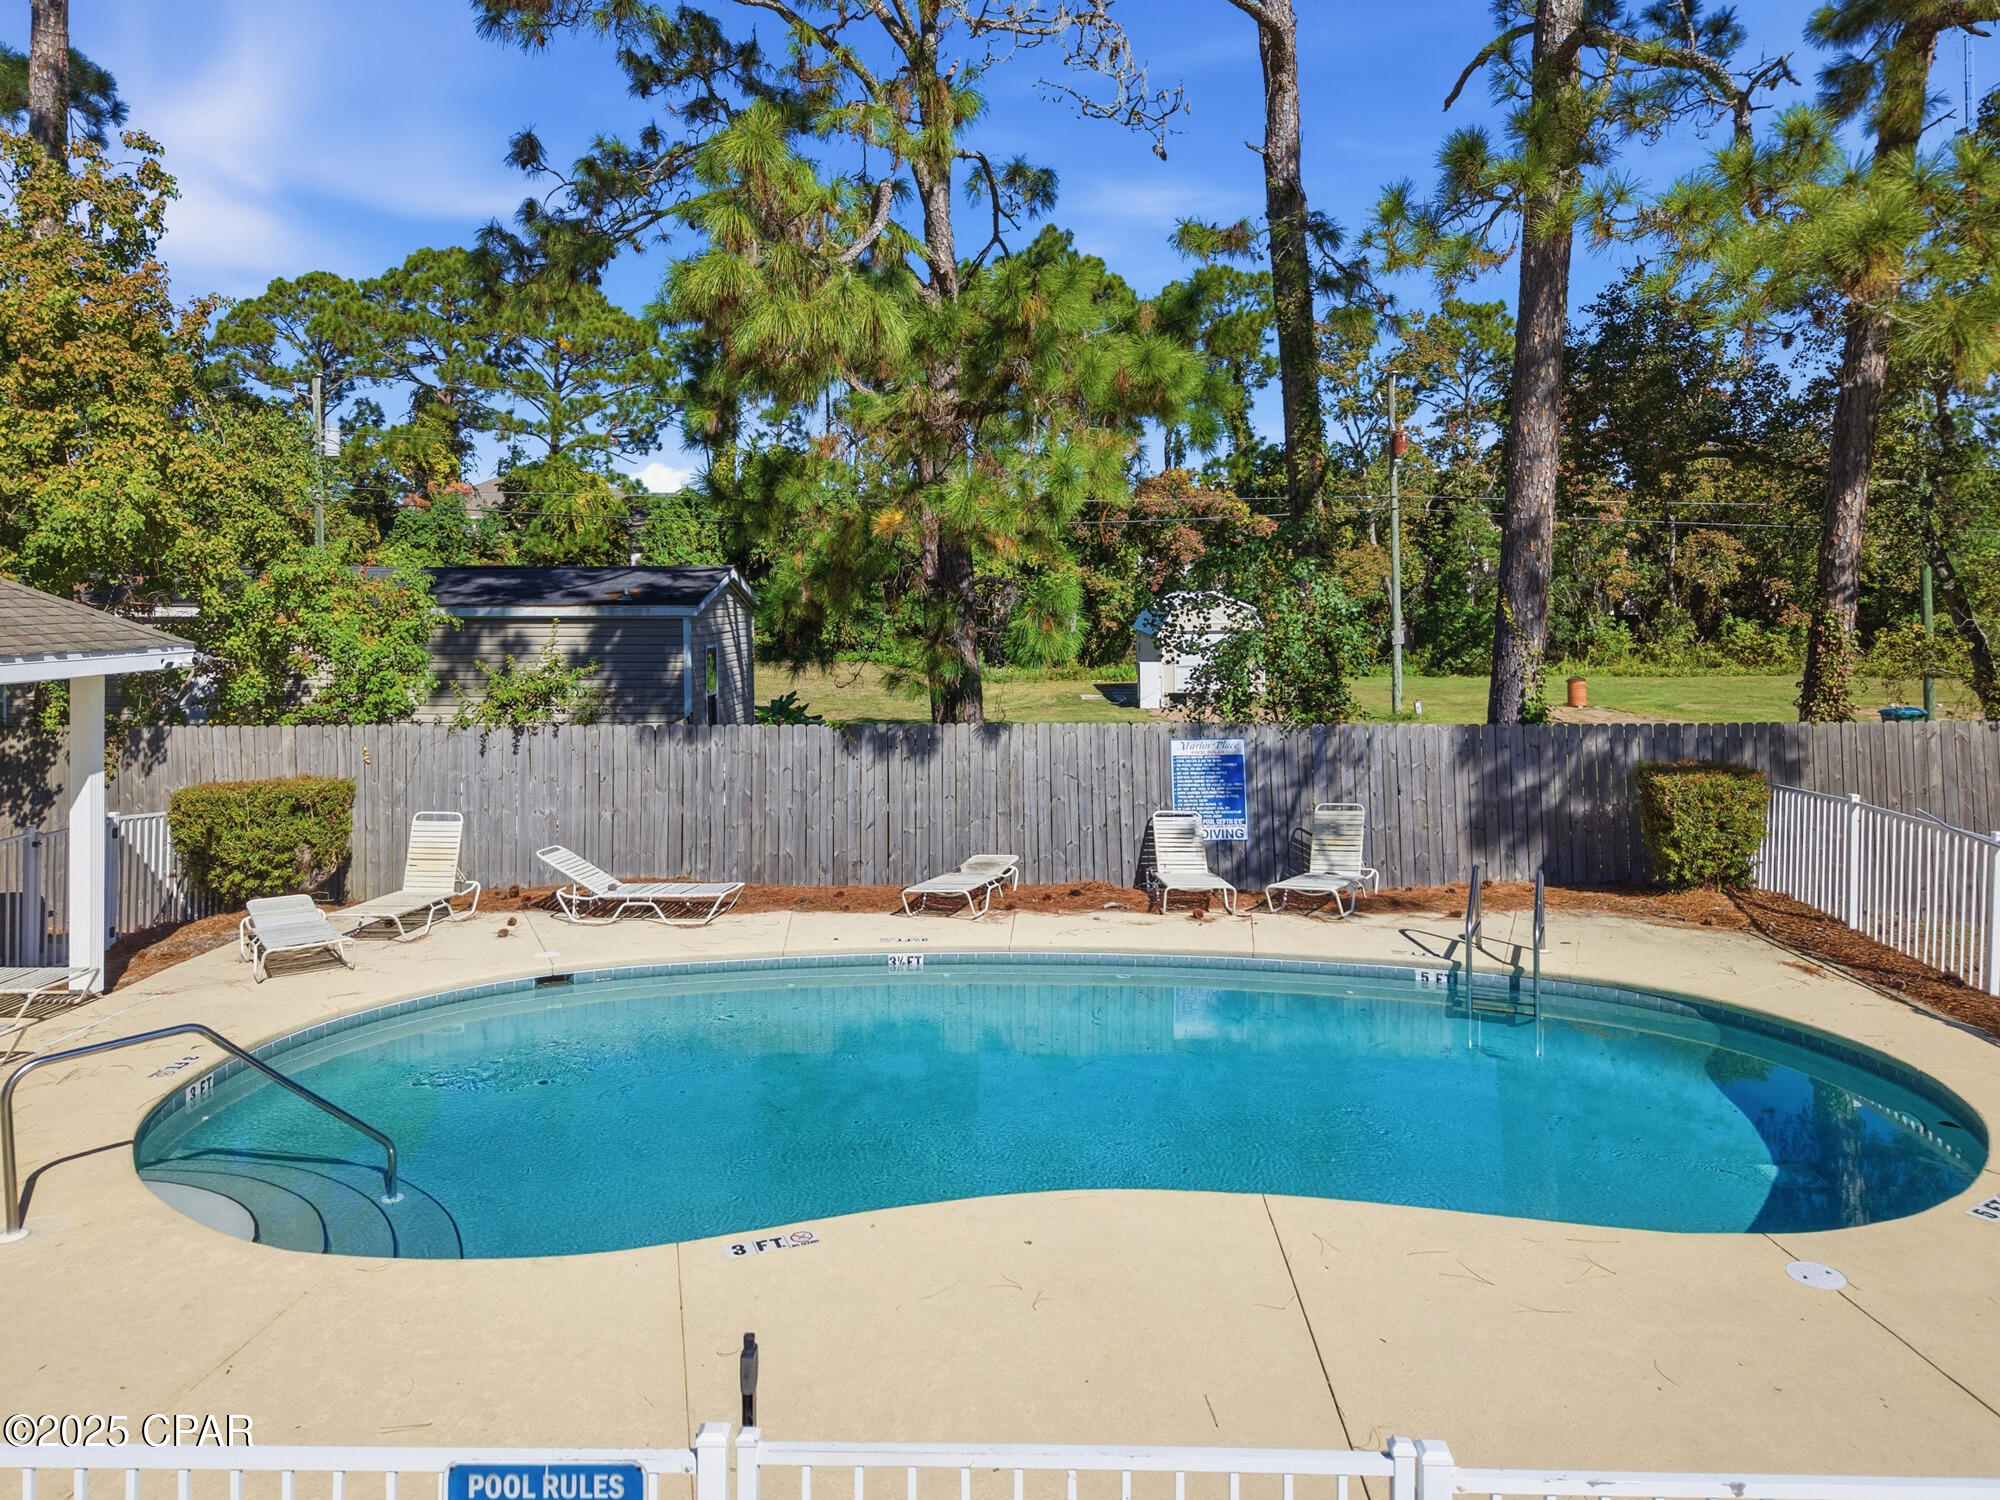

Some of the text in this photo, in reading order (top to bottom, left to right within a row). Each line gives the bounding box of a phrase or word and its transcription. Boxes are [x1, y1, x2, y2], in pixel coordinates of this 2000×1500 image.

[907, 956, 922, 966] FT
[1421, 971, 1453, 983] 5 FT
[190, 1076, 212, 1100] 3 FT
[731, 1244, 747, 1255] 3
[468, 1473, 625, 1499] POOL RULES
